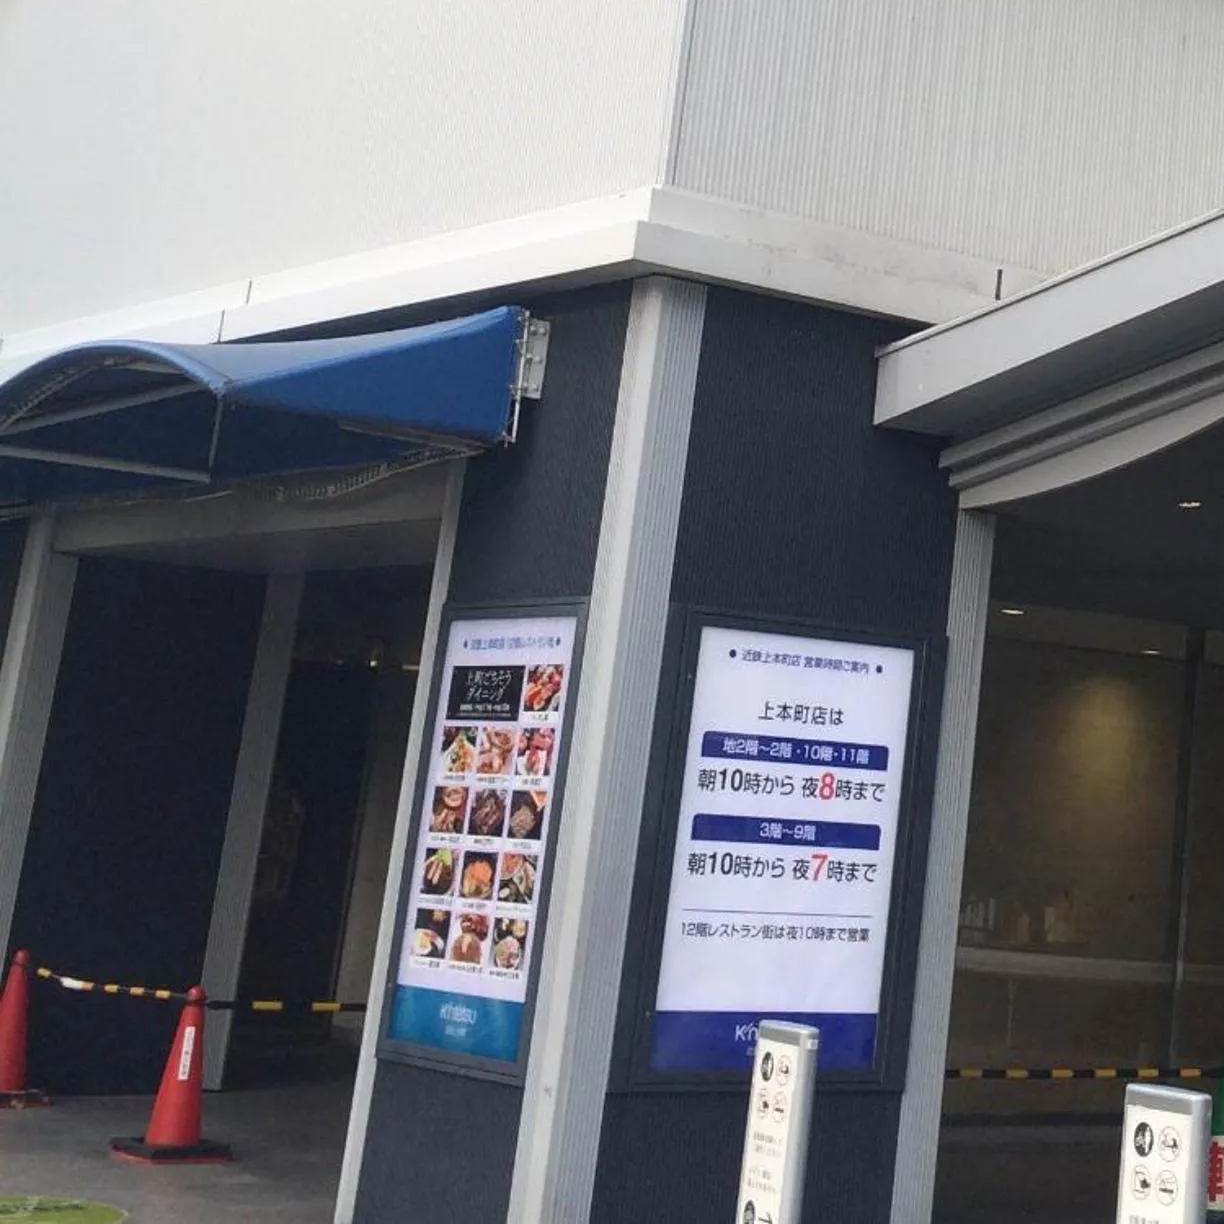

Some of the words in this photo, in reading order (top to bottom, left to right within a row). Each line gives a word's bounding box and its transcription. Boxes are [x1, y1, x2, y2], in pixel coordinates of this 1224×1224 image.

[758, 700, 844, 726] 上本町店は
[697, 768, 795, 797] 朝10時から
[802, 772, 886, 802] 夜8時まで
[687, 851, 786, 879] 朝10時から
[792, 853, 878, 883] 夜7時まで
